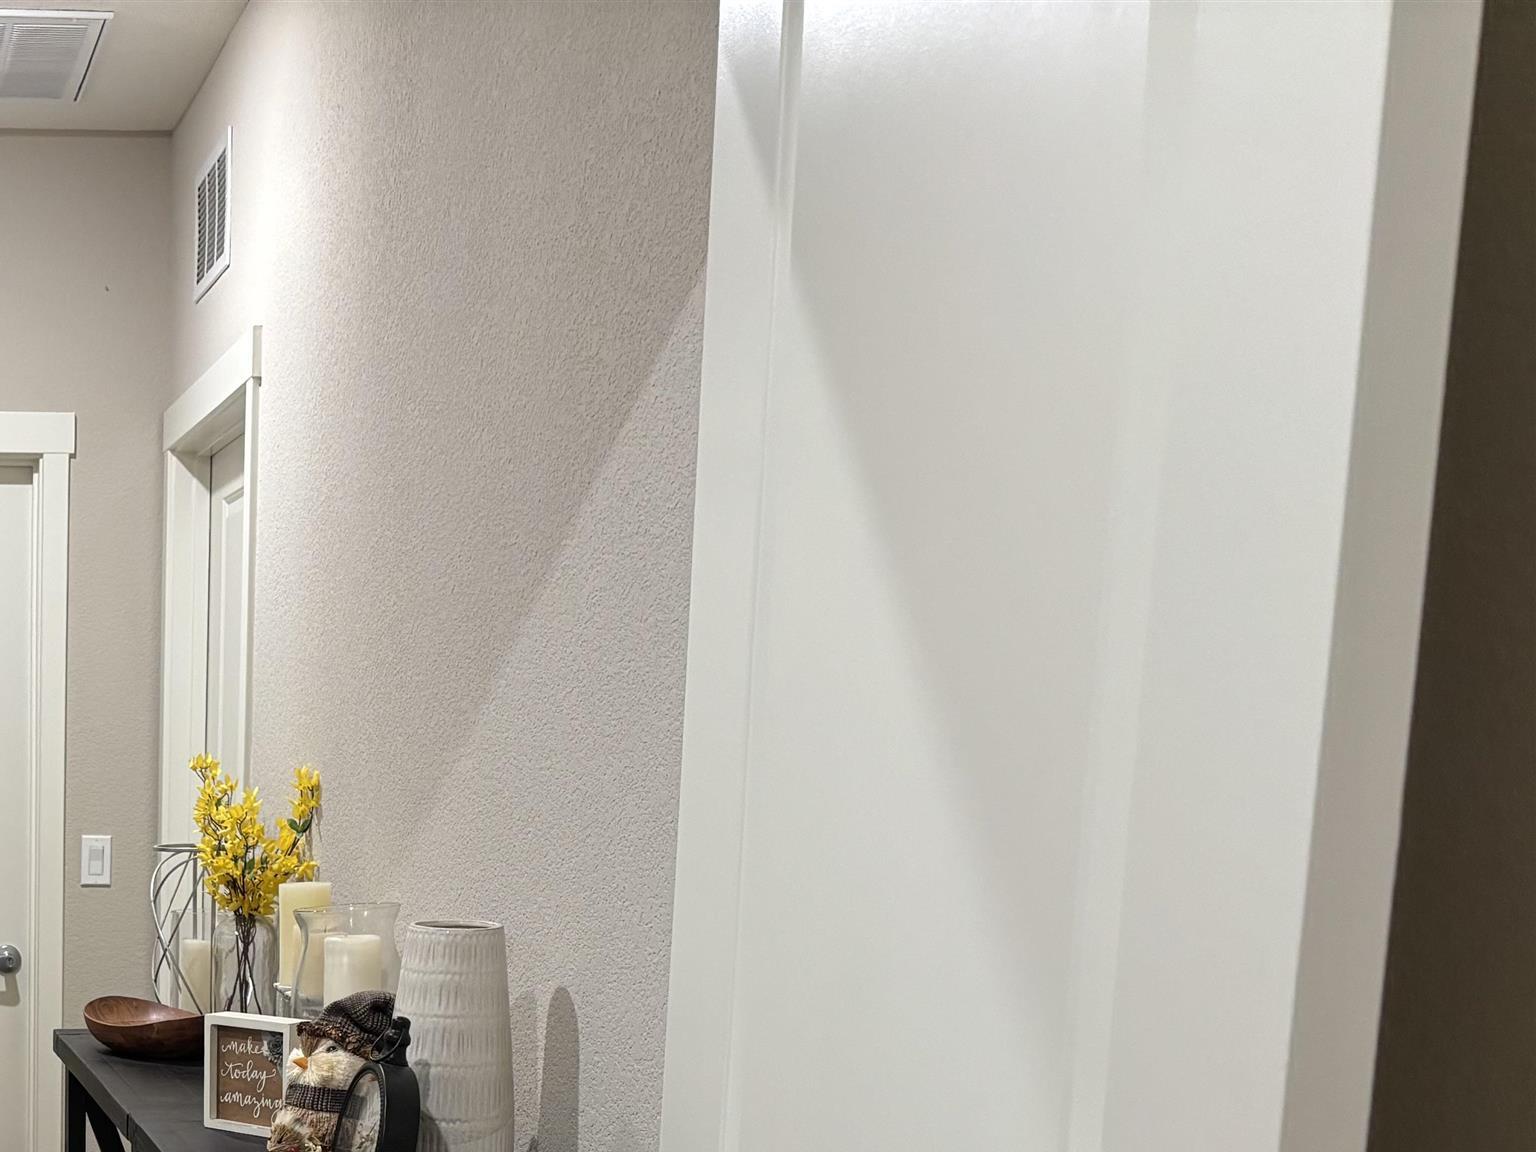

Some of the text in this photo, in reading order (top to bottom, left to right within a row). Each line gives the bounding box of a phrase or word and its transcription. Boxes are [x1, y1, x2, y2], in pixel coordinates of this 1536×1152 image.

[221, 1035, 267, 1055] make
[220, 1059, 277, 1093] today
[219, 1090, 283, 1124] amazing
